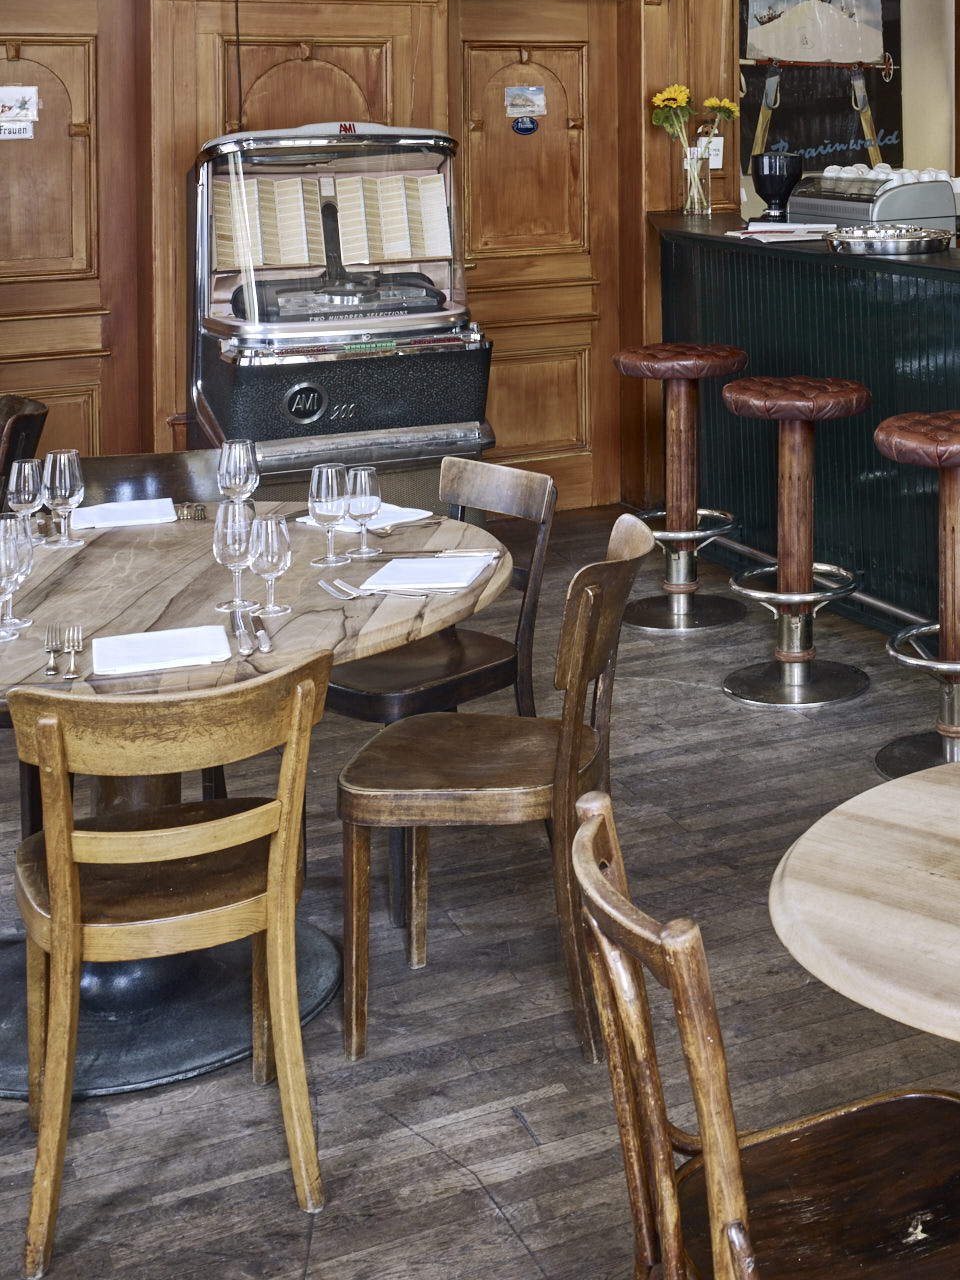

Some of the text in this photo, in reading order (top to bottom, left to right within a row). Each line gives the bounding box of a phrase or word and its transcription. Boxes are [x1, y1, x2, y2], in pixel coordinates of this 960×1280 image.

[339, 123, 356, 134] AMI
[328, 313, 362, 321] HUNDRED
[366, 310, 409, 318] SELECTIONS
[291, 393, 318, 412] AMI
